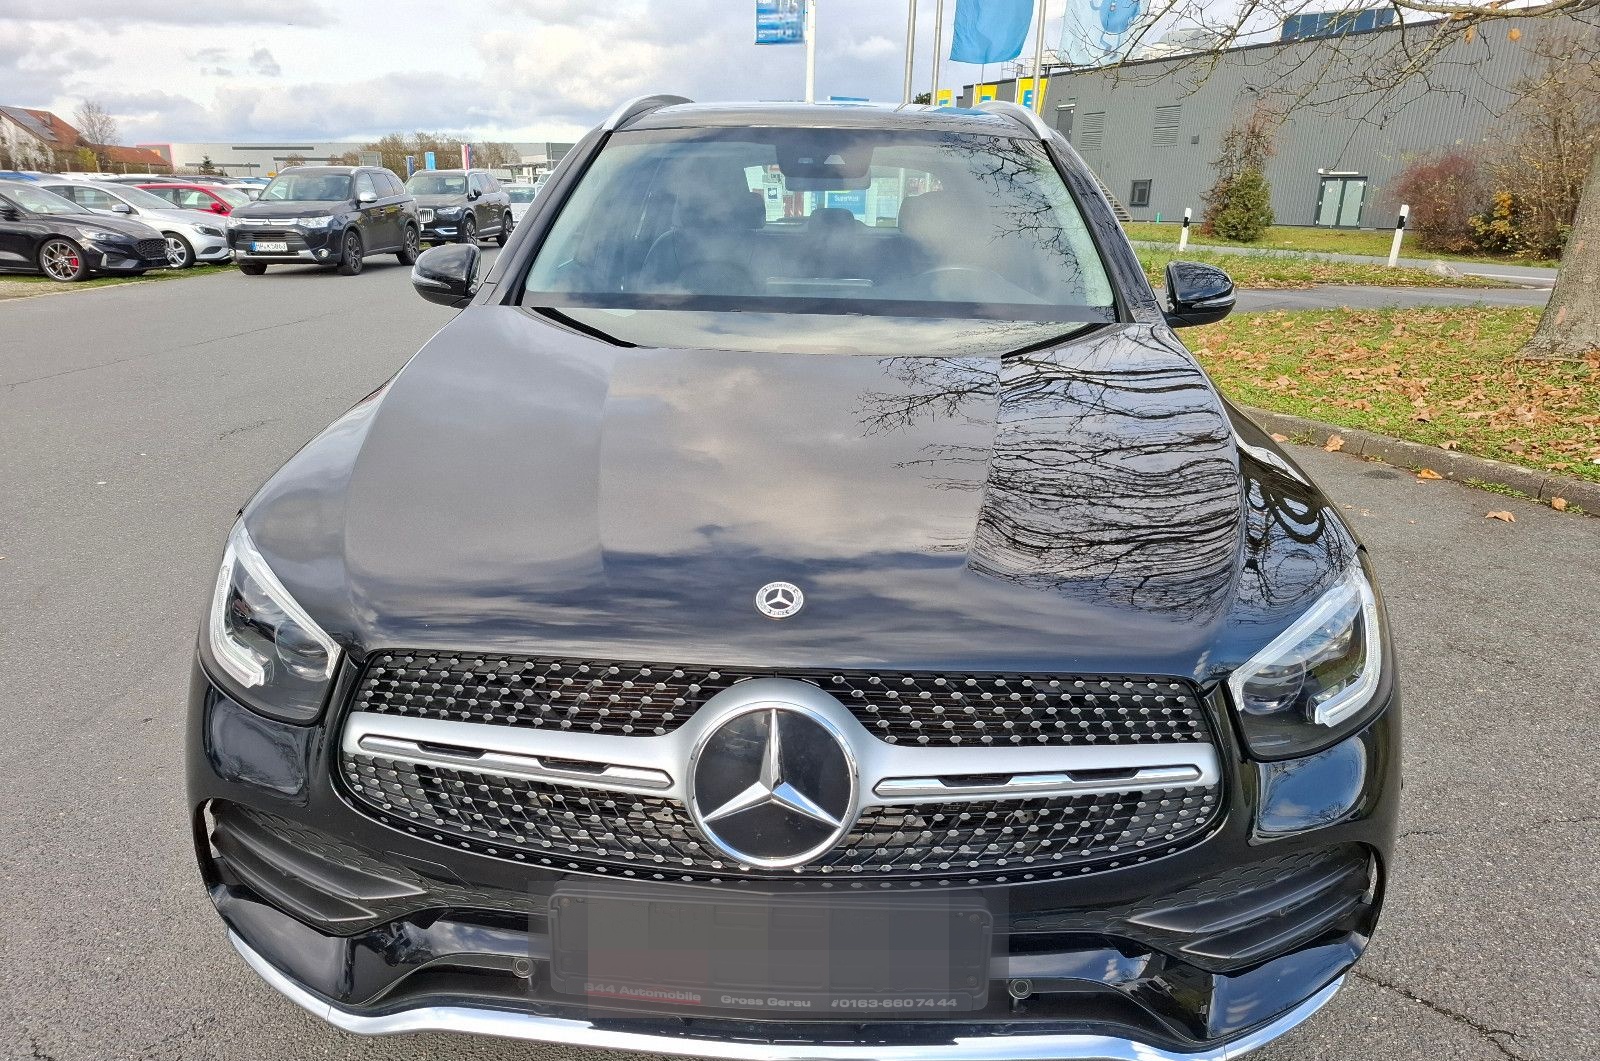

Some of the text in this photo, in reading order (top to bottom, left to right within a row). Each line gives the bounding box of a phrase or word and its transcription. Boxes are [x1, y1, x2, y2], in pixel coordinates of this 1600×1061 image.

[619, 985, 702, 1001] Automobile
[720, 995, 811, 1008] Gross Gerau
